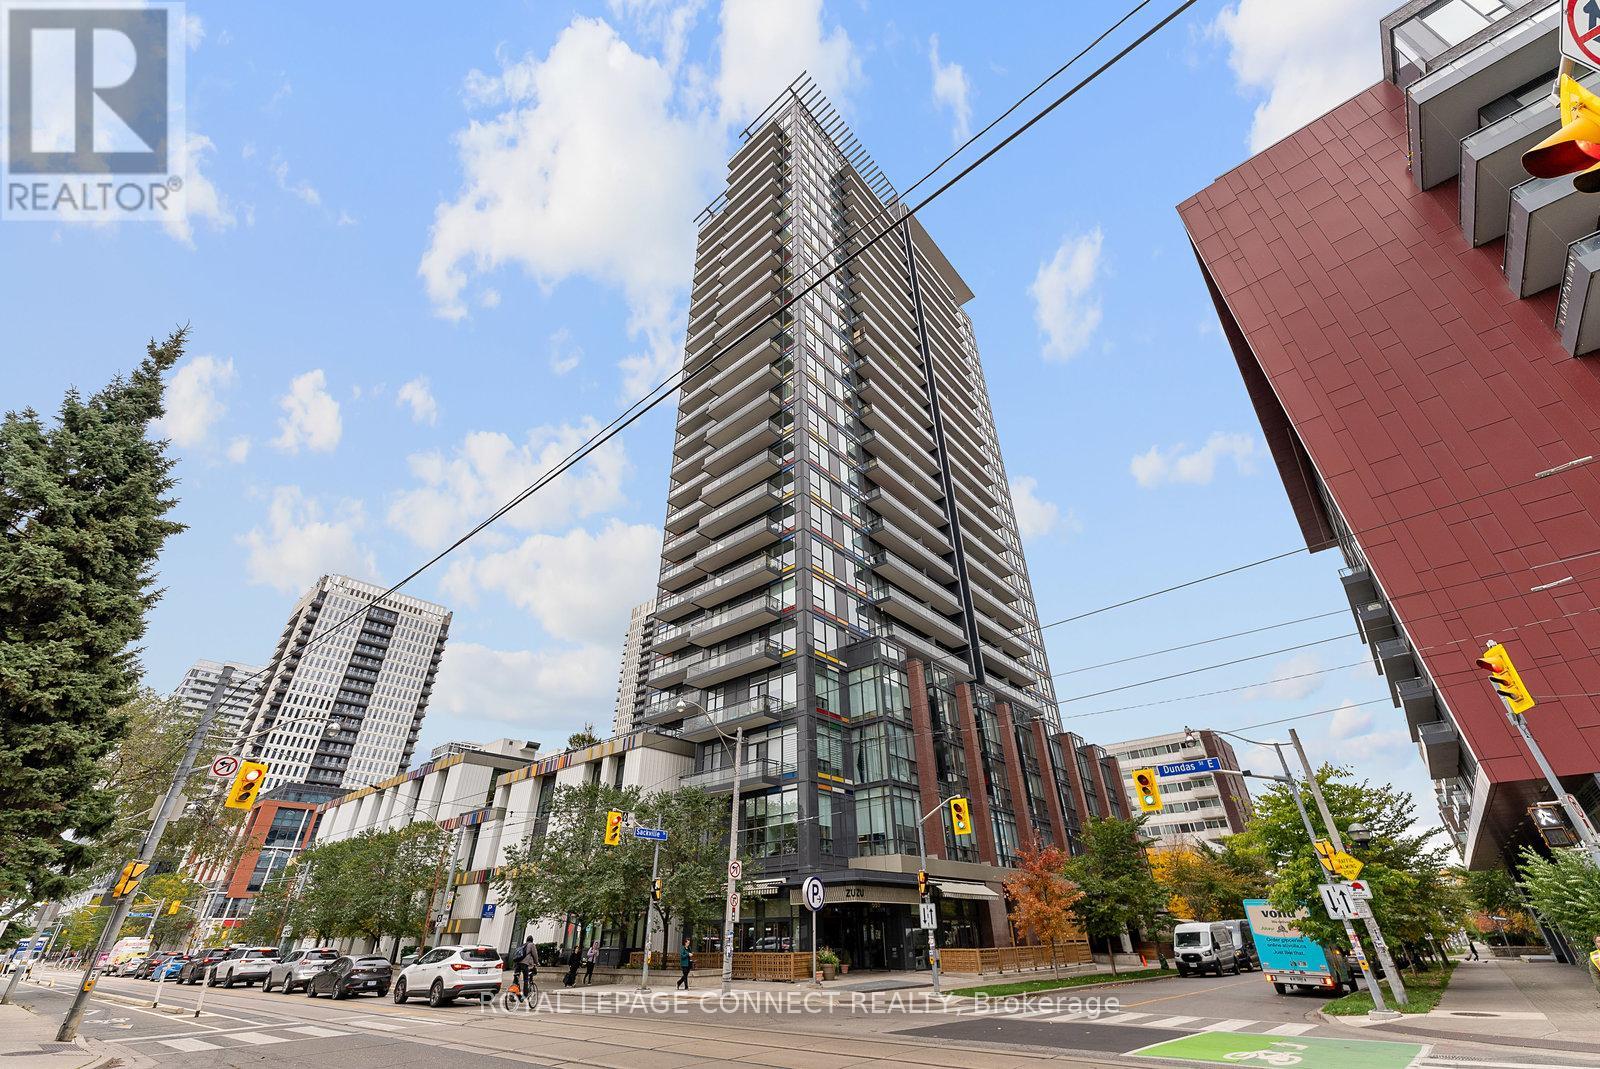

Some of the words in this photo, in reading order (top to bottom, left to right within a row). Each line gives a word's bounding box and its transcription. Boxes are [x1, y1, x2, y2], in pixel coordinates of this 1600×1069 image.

[1163, 763, 1196, 774] Dundas
[1207, 760, 1214, 768] E
[812, 884, 820, 903] P
[487, 904, 493, 912] P
